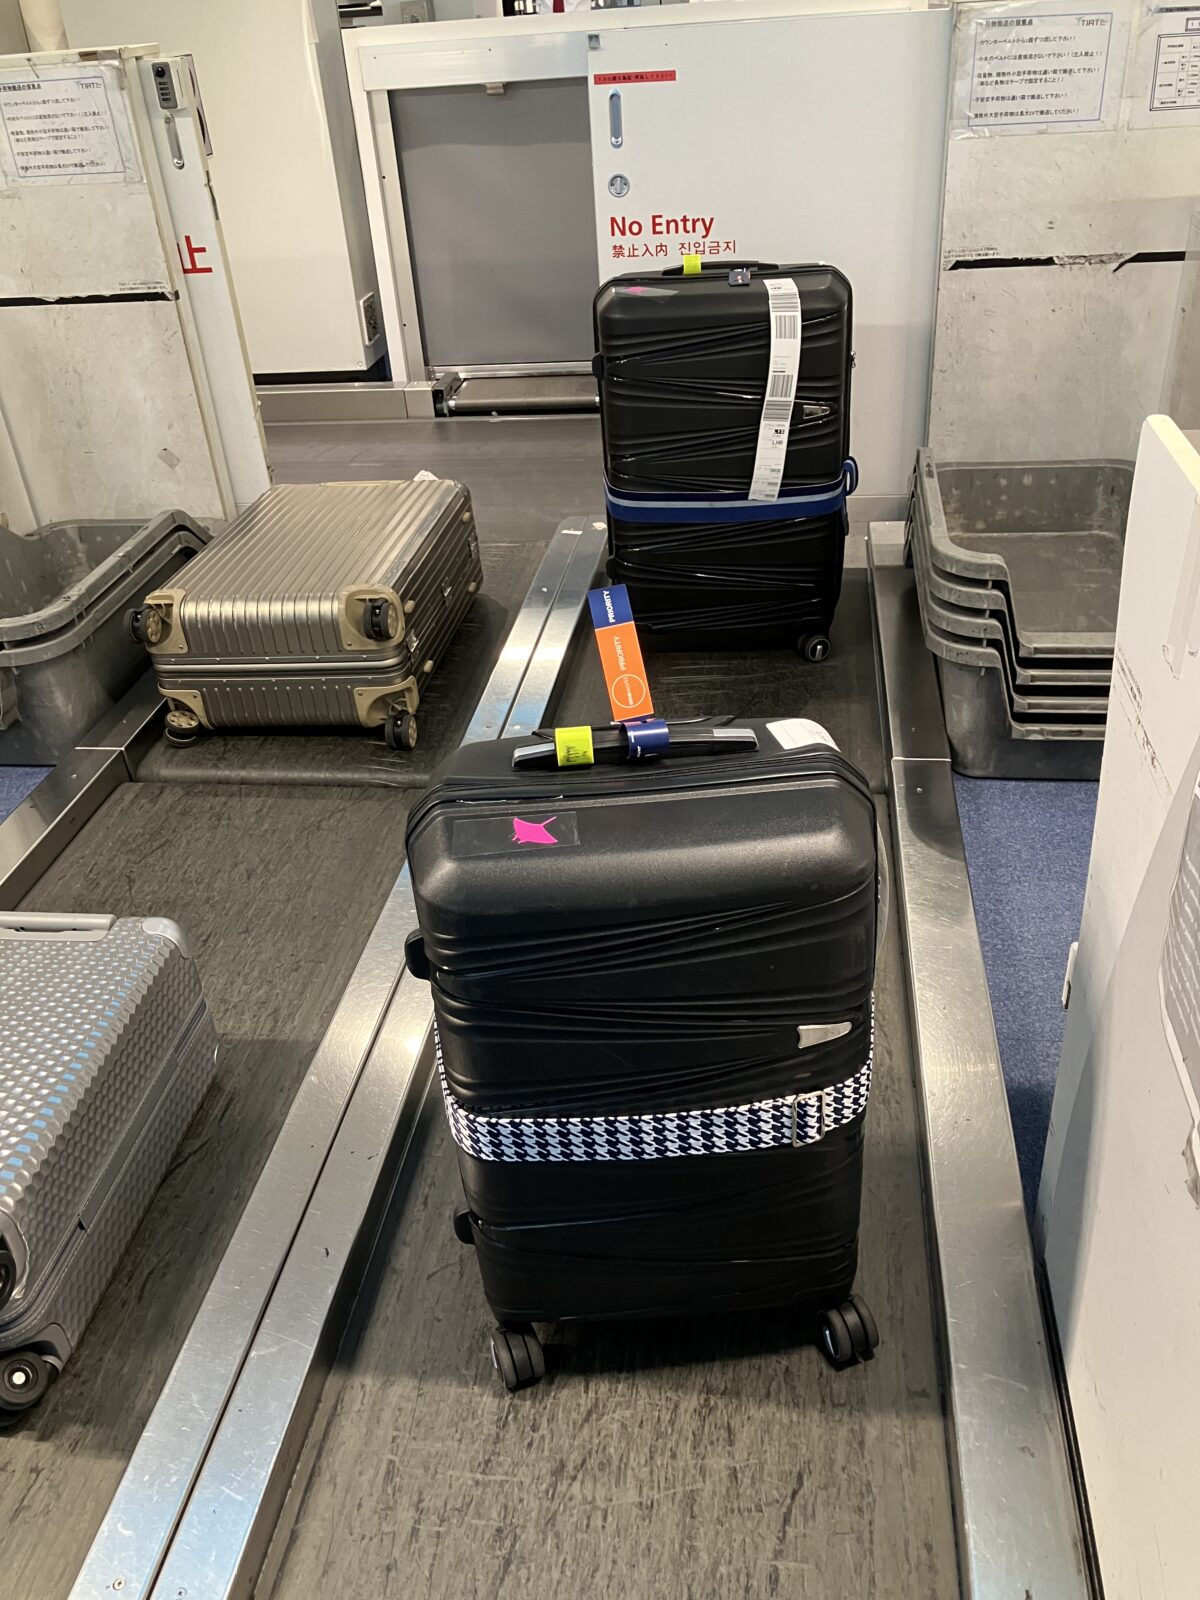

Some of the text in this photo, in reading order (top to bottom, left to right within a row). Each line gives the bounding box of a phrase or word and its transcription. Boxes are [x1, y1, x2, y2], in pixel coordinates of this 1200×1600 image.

[610, 214, 715, 239] No Entry
[177, 235, 213, 274] 止
[612, 242, 668, 259] 禁止入内
[678, 239, 736, 256] 진입금지
[603, 590, 616, 623] PRIORITY
[614, 636, 627, 671] PRIORITY
